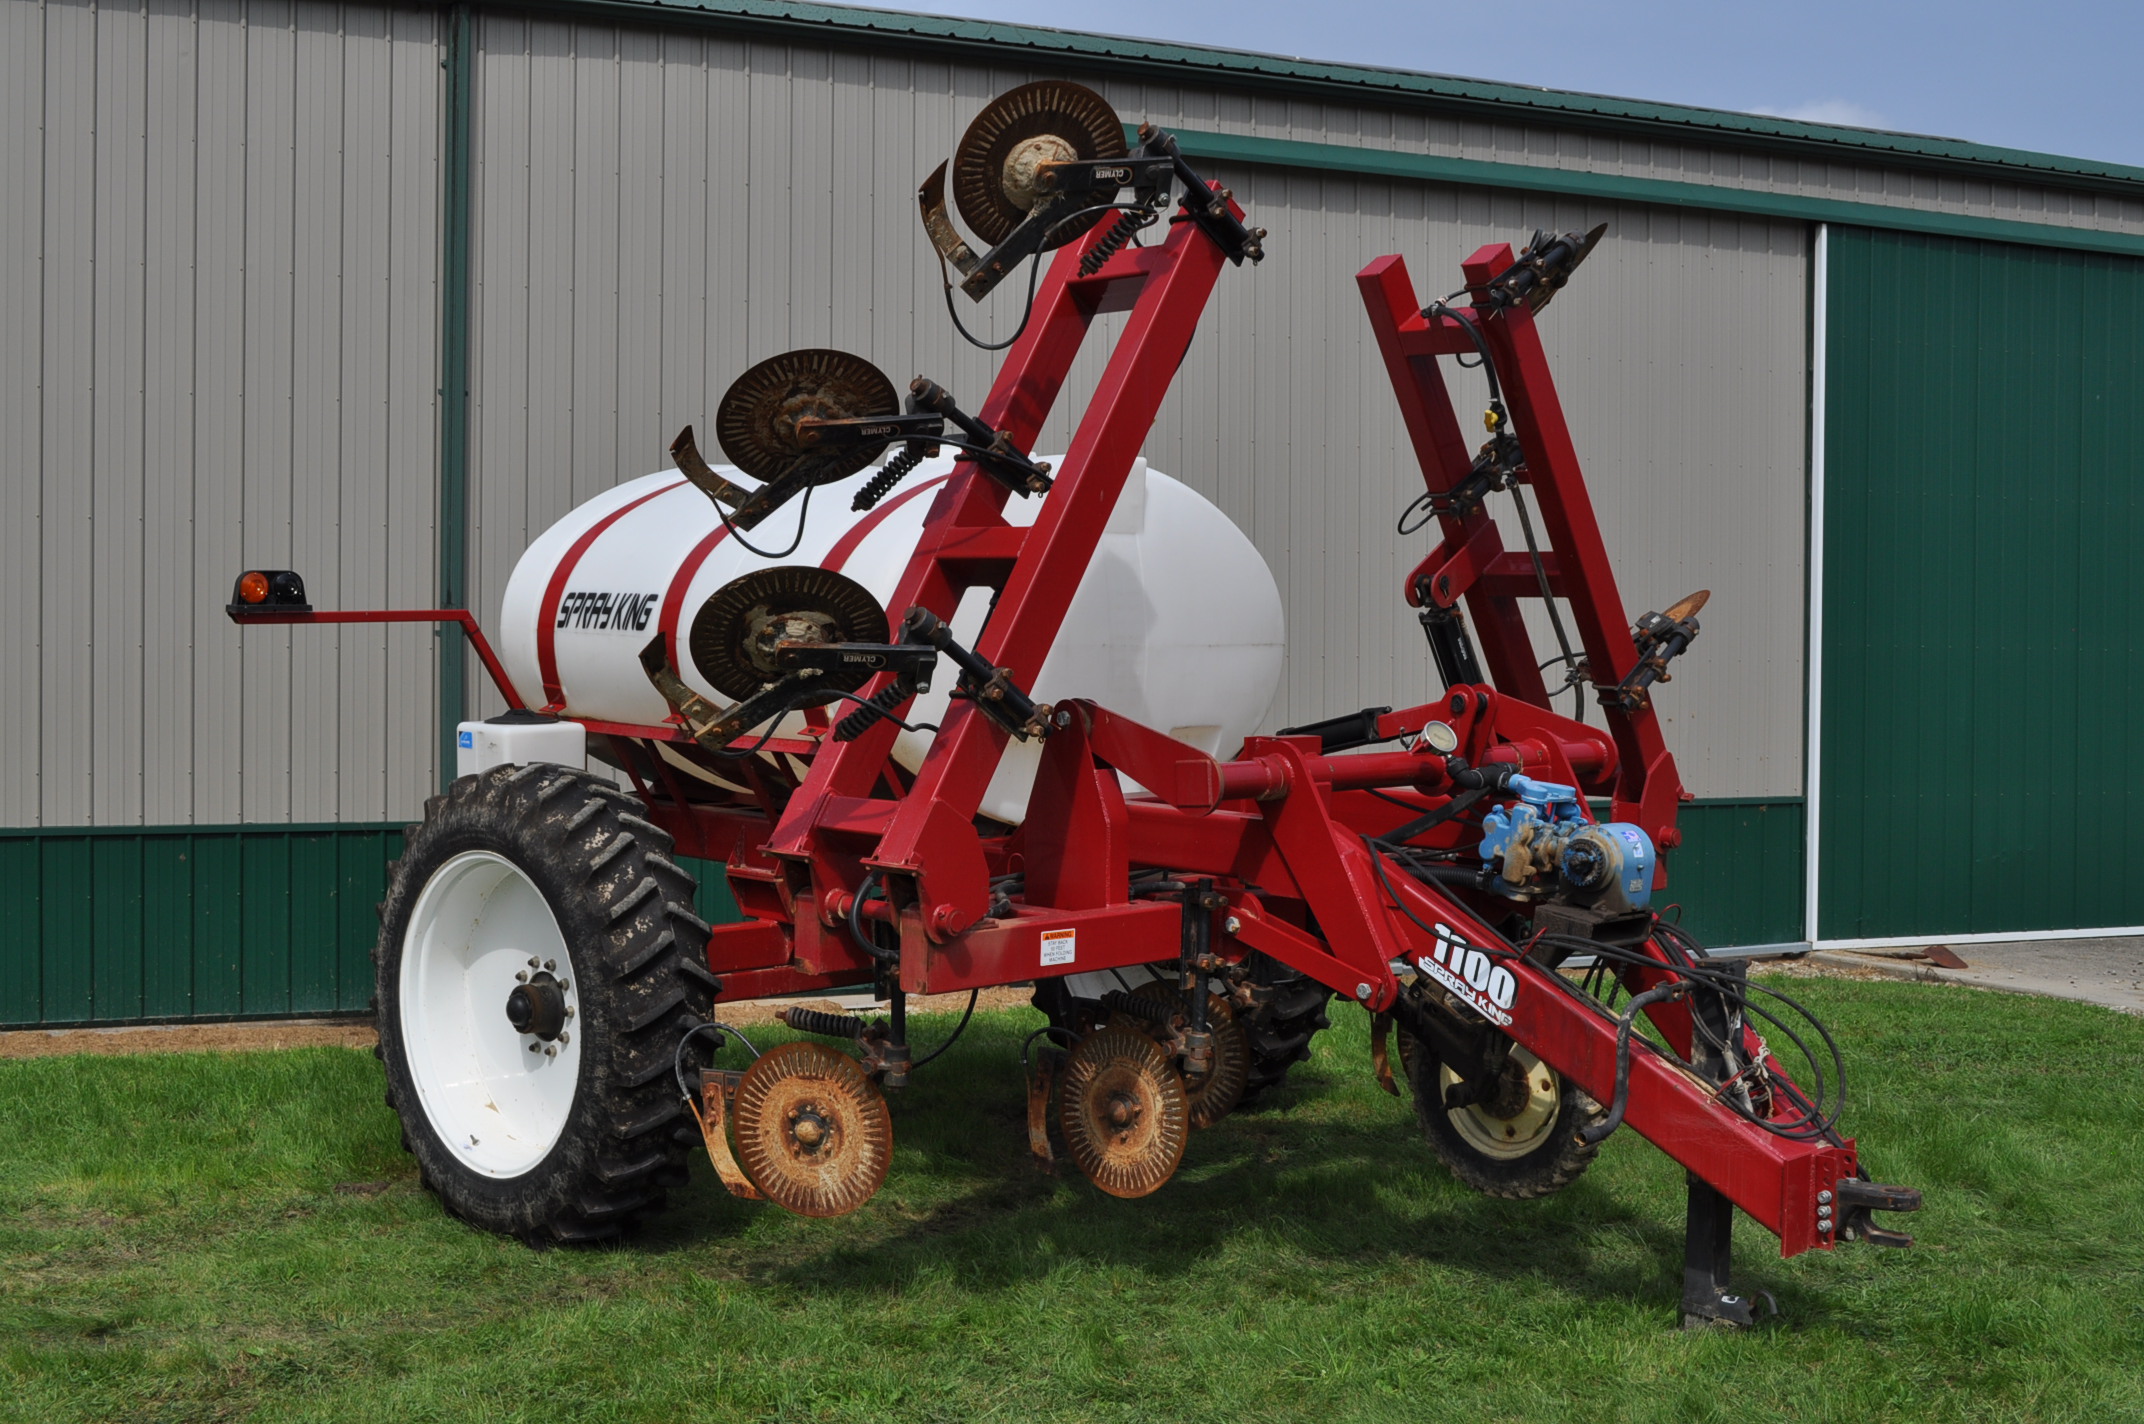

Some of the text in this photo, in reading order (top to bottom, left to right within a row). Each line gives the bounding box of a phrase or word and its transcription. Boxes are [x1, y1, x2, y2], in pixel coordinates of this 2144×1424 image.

[1096, 169, 1124, 178] CLYMER
[861, 426, 891, 435] CLYMER
[557, 592, 659, 631] SPRAY KING
[843, 655, 877, 663] CLYMER
[1050, 931, 1072, 939] WARNING
[1434, 923, 1518, 1010] 1100
[1424, 956, 1513, 1027] SPRAY KING
